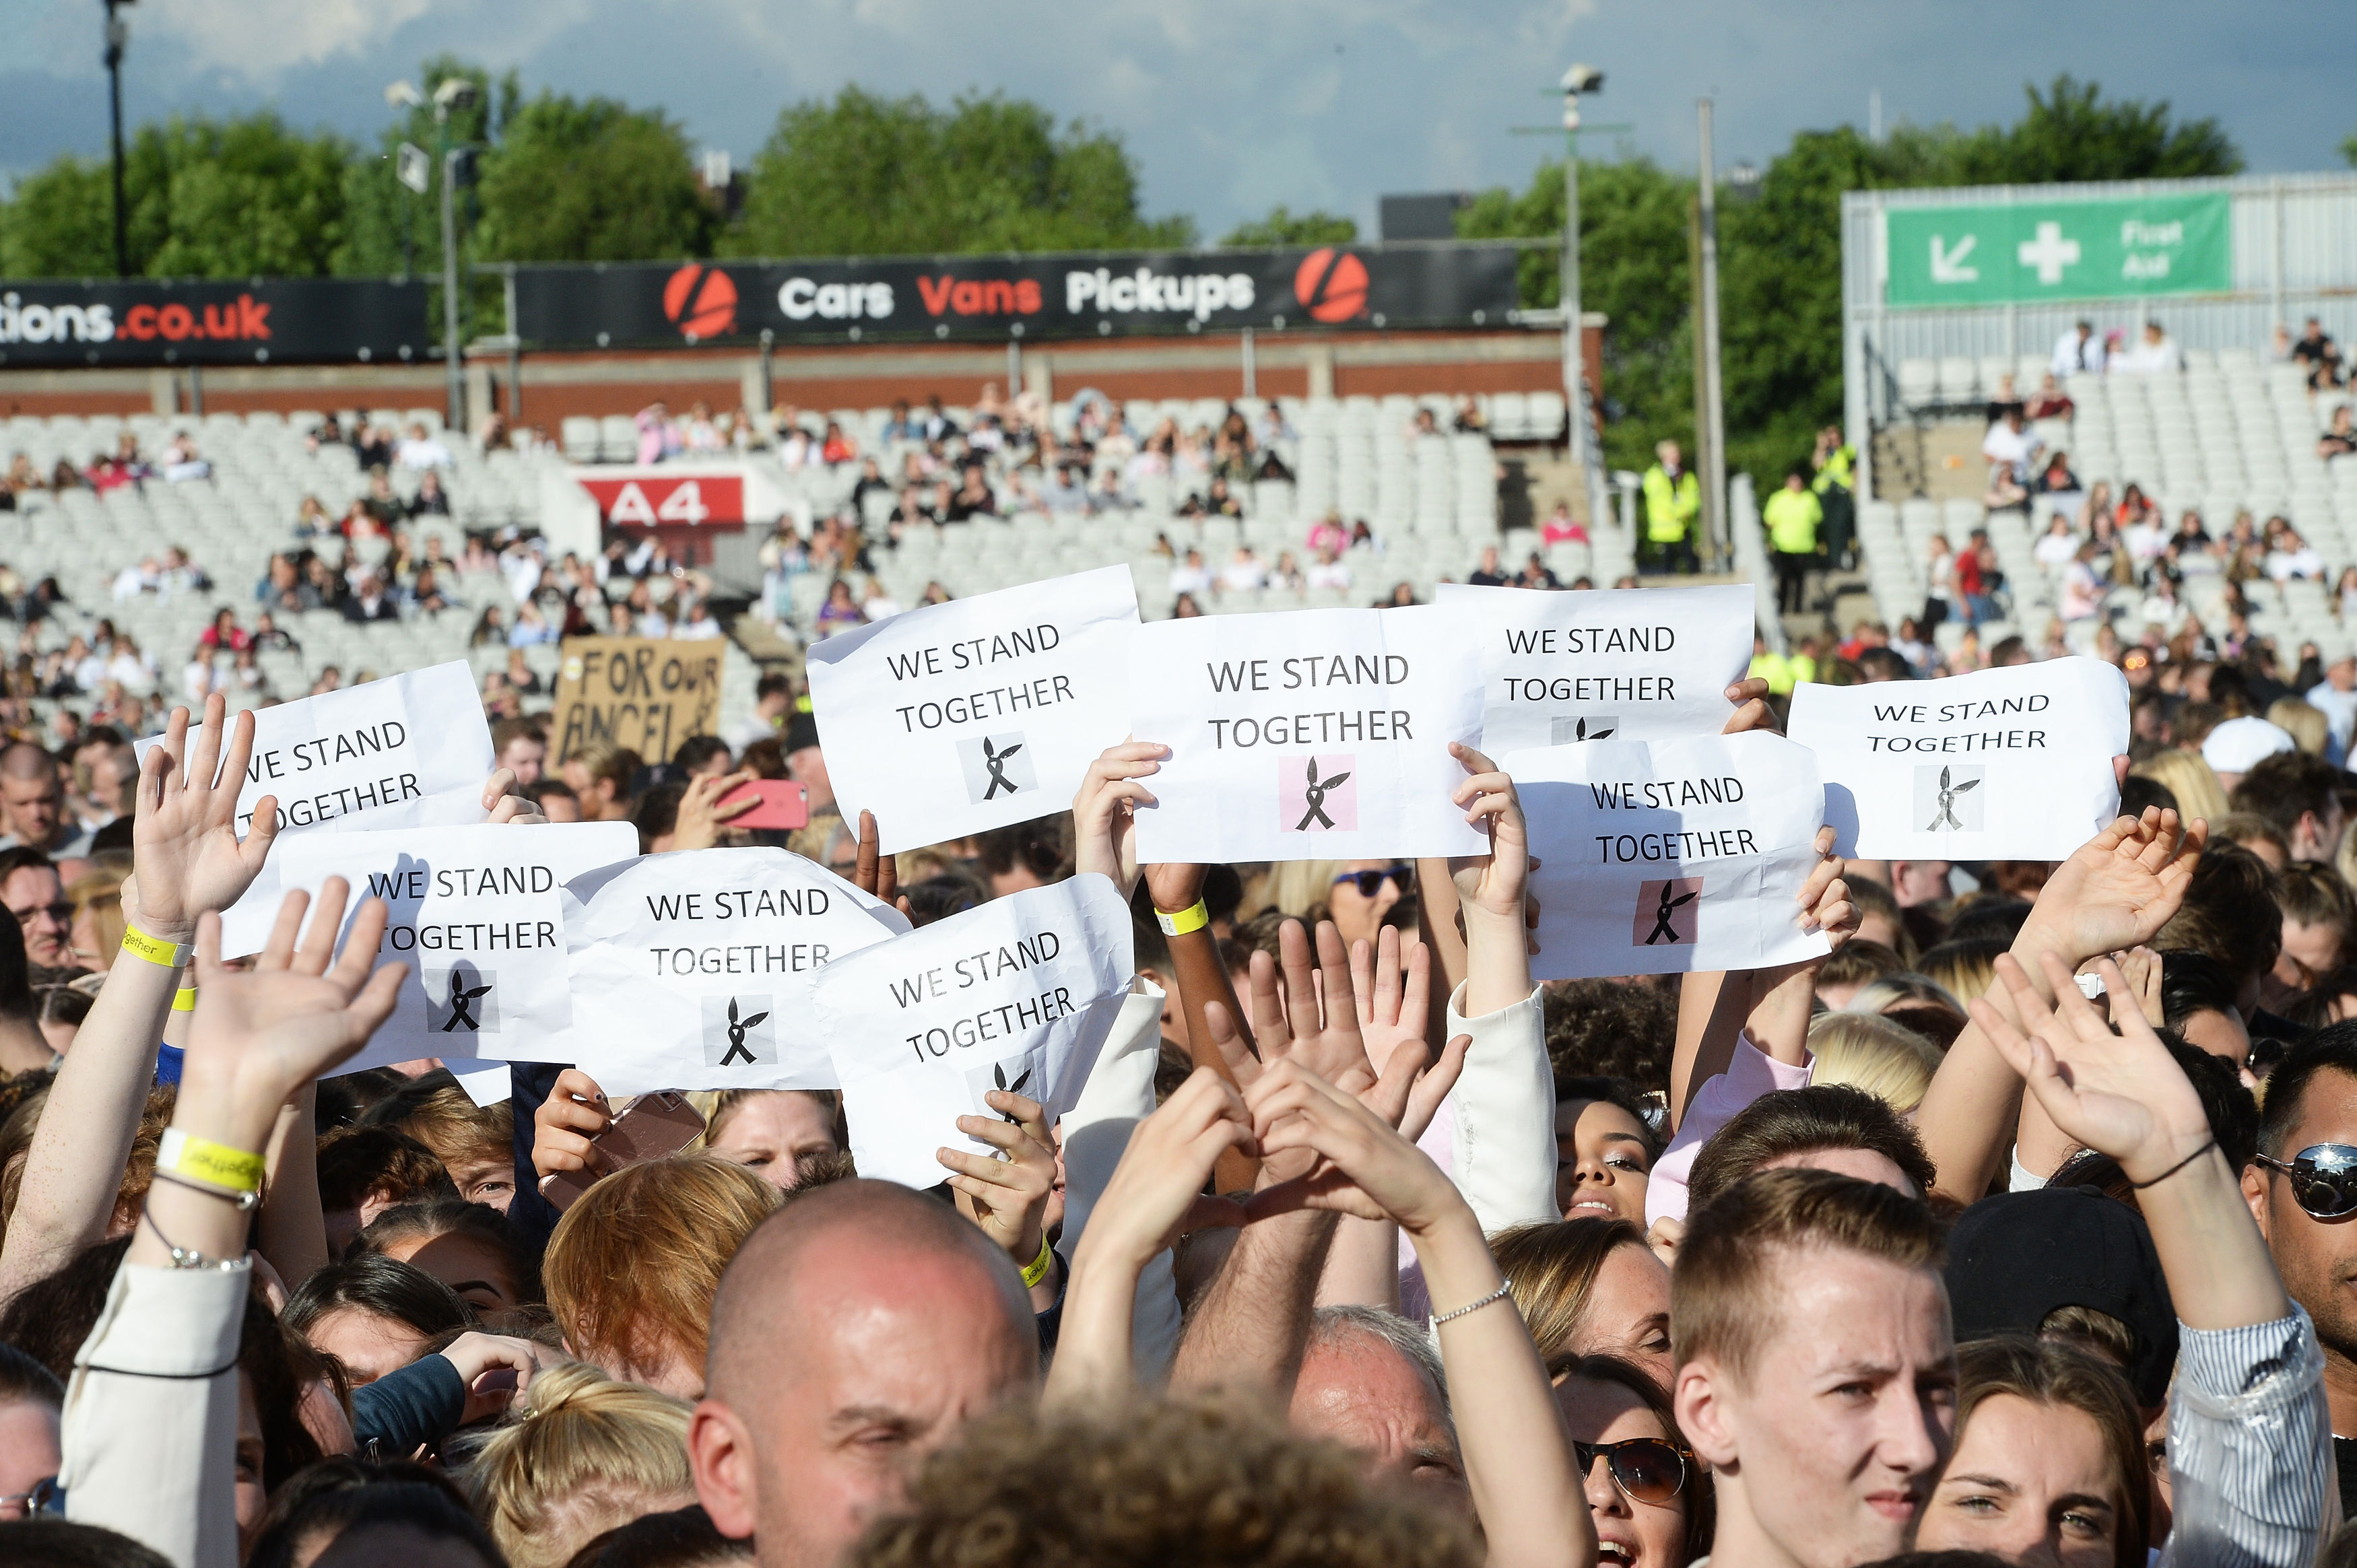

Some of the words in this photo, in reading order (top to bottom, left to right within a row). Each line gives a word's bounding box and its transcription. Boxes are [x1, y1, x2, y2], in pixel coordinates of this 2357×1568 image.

[2121, 219, 2183, 246] First
[2121, 252, 2170, 280] Aid
[778, 277, 895, 320] Cars
[917, 274, 1043, 316] Vans
[1066, 267, 1256, 322] Pickups
[609, 481, 710, 527] A4
[887, 647, 943, 681] WE
[952, 624, 1059, 669] STAND
[1506, 629, 1556, 654] WE
[1568, 627, 1675, 653] STAND
[581, 647, 655, 697] FOR
[661, 656, 718, 691] OUR
[1207, 660, 1269, 692] WE
[1283, 655, 1408, 689] STAND
[1504, 677, 1675, 701] TOGETHER
[896, 675, 1074, 732] TOGETHER
[1874, 705, 1927, 722] WE
[1938, 695, 2049, 722] STAND
[293, 722, 405, 771] STAND
[1207, 710, 1412, 749] TOGETHER
[1867, 730, 2046, 752] TOGETHER
[1591, 782, 1637, 809] WE
[1644, 777, 1744, 809] STAND
[1595, 829, 1758, 863] TOGETHER
[368, 871, 424, 900] WE
[437, 866, 553, 897] STAND
[646, 894, 703, 920] WE
[715, 889, 829, 920] STAND
[650, 944, 830, 976] TOGETHER
[890, 967, 947, 1008] WE
[955, 932, 1059, 988] STAND
[906, 987, 1075, 1062] TOGETHER
